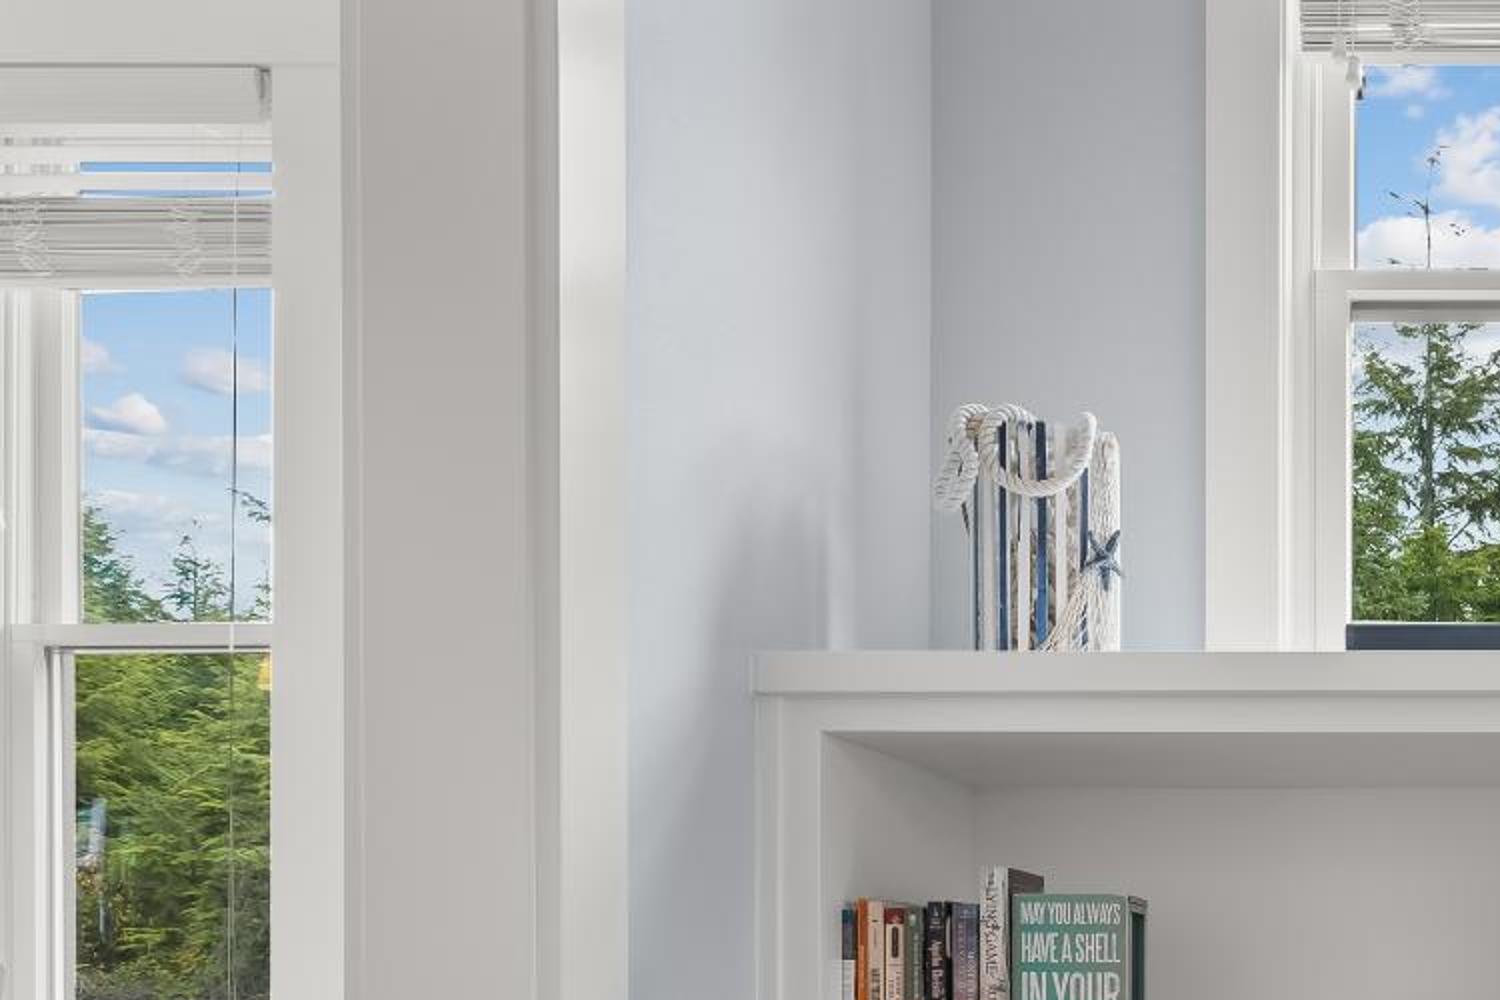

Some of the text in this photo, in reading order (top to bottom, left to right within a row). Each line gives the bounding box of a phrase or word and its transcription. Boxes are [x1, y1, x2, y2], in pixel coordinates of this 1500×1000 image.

[1020, 902, 1121, 925] MAY YOU ALWAYS
[1021, 933, 1121, 963] HAVE A SHELL
